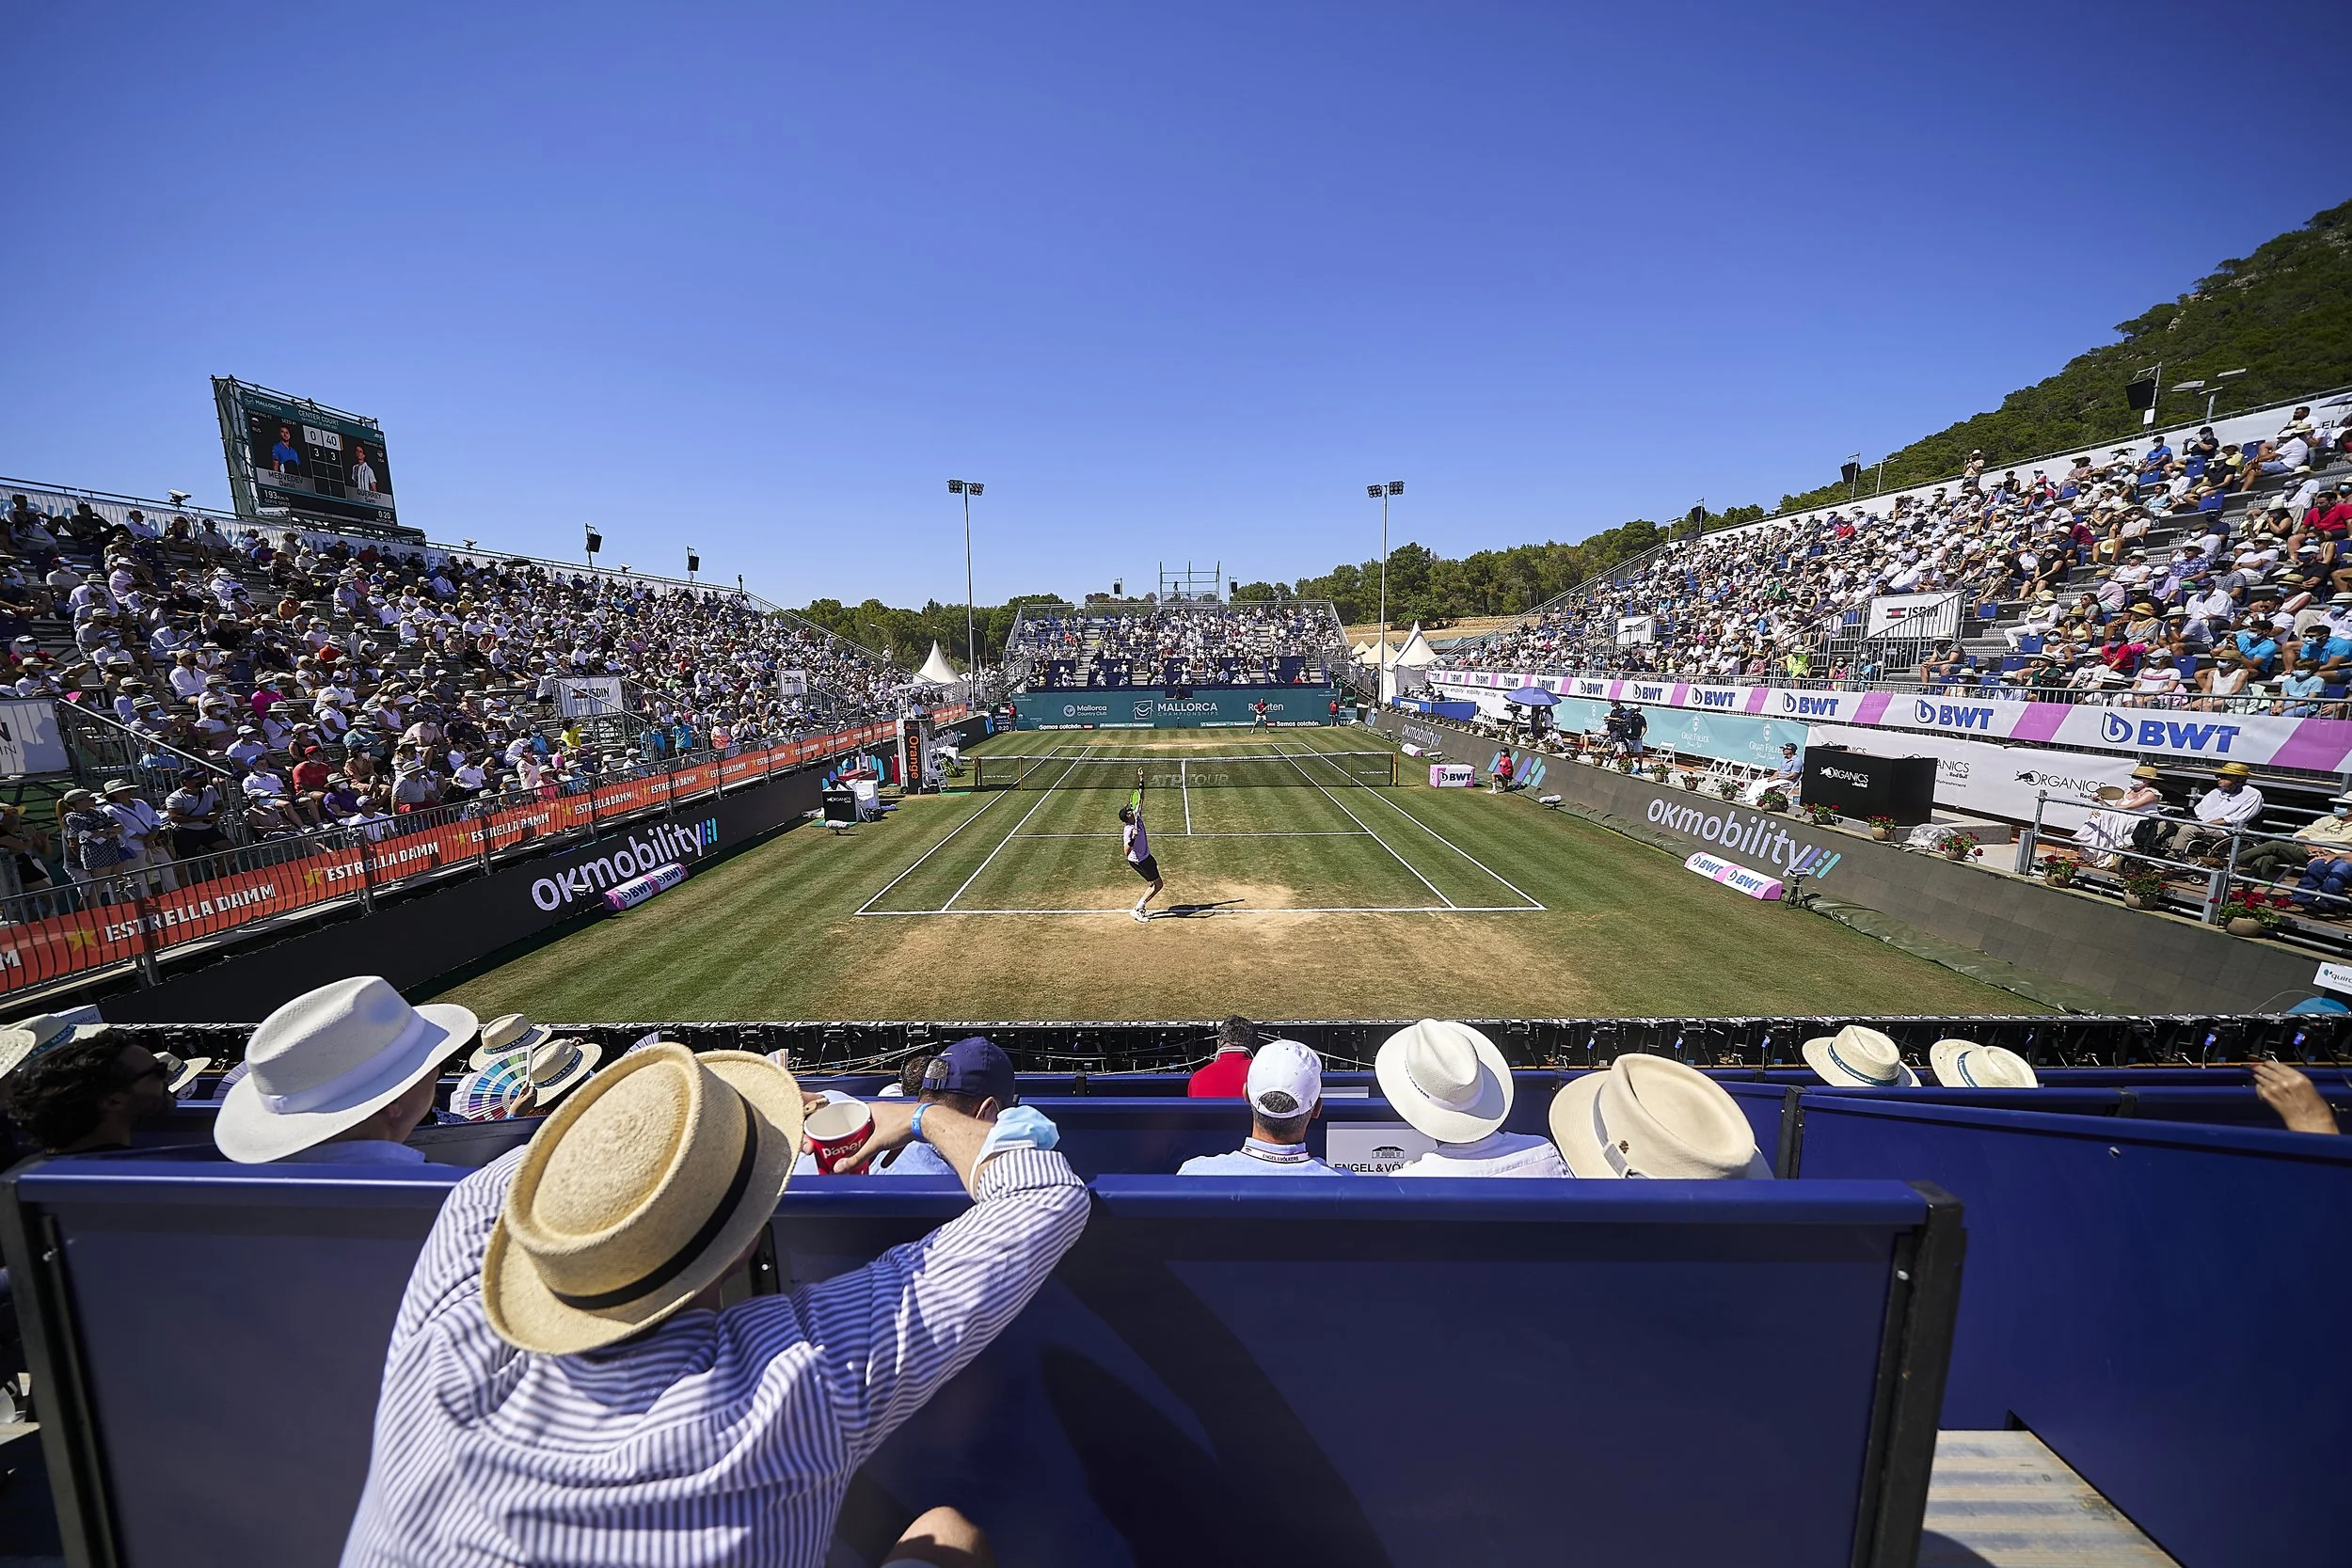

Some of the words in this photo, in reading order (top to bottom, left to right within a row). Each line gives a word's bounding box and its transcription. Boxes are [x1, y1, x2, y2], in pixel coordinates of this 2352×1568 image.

[255, 400, 282, 411] MALLORCA
[298, 410, 320, 421] CENTER
[321, 415, 339, 426] COURT
[310, 431, 316, 440] 0
[326, 436, 336, 446] 40
[314, 448, 319, 457] 3
[331, 452, 336, 460] 3
[268, 471, 303, 484] MEDVEDEV
[264, 490, 277, 499] 193
[357, 490, 382, 499] QUERREY
[1508, 677, 1519, 687] BWT
[1541, 680, 1556, 690] BWT
[1587, 683, 1604, 695] BWT
[589, 687, 610, 698] ISDIN
[1642, 687, 1663, 701] BWT
[1704, 691, 1736, 707] BWT
[1157, 703, 1218, 712] MALLORCA
[1248, 703, 1284, 711] Raten
[1798, 697, 1839, 716] BWT
[1939, 705, 1994, 729] BWT
[1402, 724, 1437, 749] okmobility
[1681, 731, 1693, 740] GRAN
[2137, 720, 2241, 753] BWT
[1749, 741, 1764, 750] GRAN
[1766, 744, 1782, 753] FOLIE
[909, 736, 919, 779] Orange
[710, 768, 732, 778] ESTRELLA
[732, 763, 746, 772] DAMM
[1936, 759, 1970, 773] ANICS
[1149, 774, 1184, 785] ATP
[1186, 774, 1229, 785] TOUR
[1826, 767, 1869, 783] ORGANICS
[651, 781, 679, 795] ESTRELLA
[680, 775, 697, 787] DAMM
[575, 797, 611, 815] ESTRELLA
[611, 792, 632, 805] DAMM
[470, 820, 519, 844] ESTRELLA
[521, 813, 550, 830] DAMM
[1647, 799, 1812, 877] okmobility
[326, 853, 398, 882] ESTRELLA
[400, 842, 439, 863] DAMM
[531, 822, 702, 911] okmobility
[1699, 859, 1723, 874] BWT
[664, 866, 683, 883] BWT
[1735, 875, 1763, 891] BWT
[630, 881, 652, 901] BWT
[104, 902, 215, 942] ESTRELLA
[216, 884, 276, 913] DAMM
[492, 1044, 511, 1053] MARCH
[523, 1028, 533, 1038] MARC
[573, 1050, 581, 1063] MARC
[544, 1071, 563, 1085] MARCH
[1376, 1164, 1384, 1172] &
[1385, 1162, 1404, 1172] VÖ
